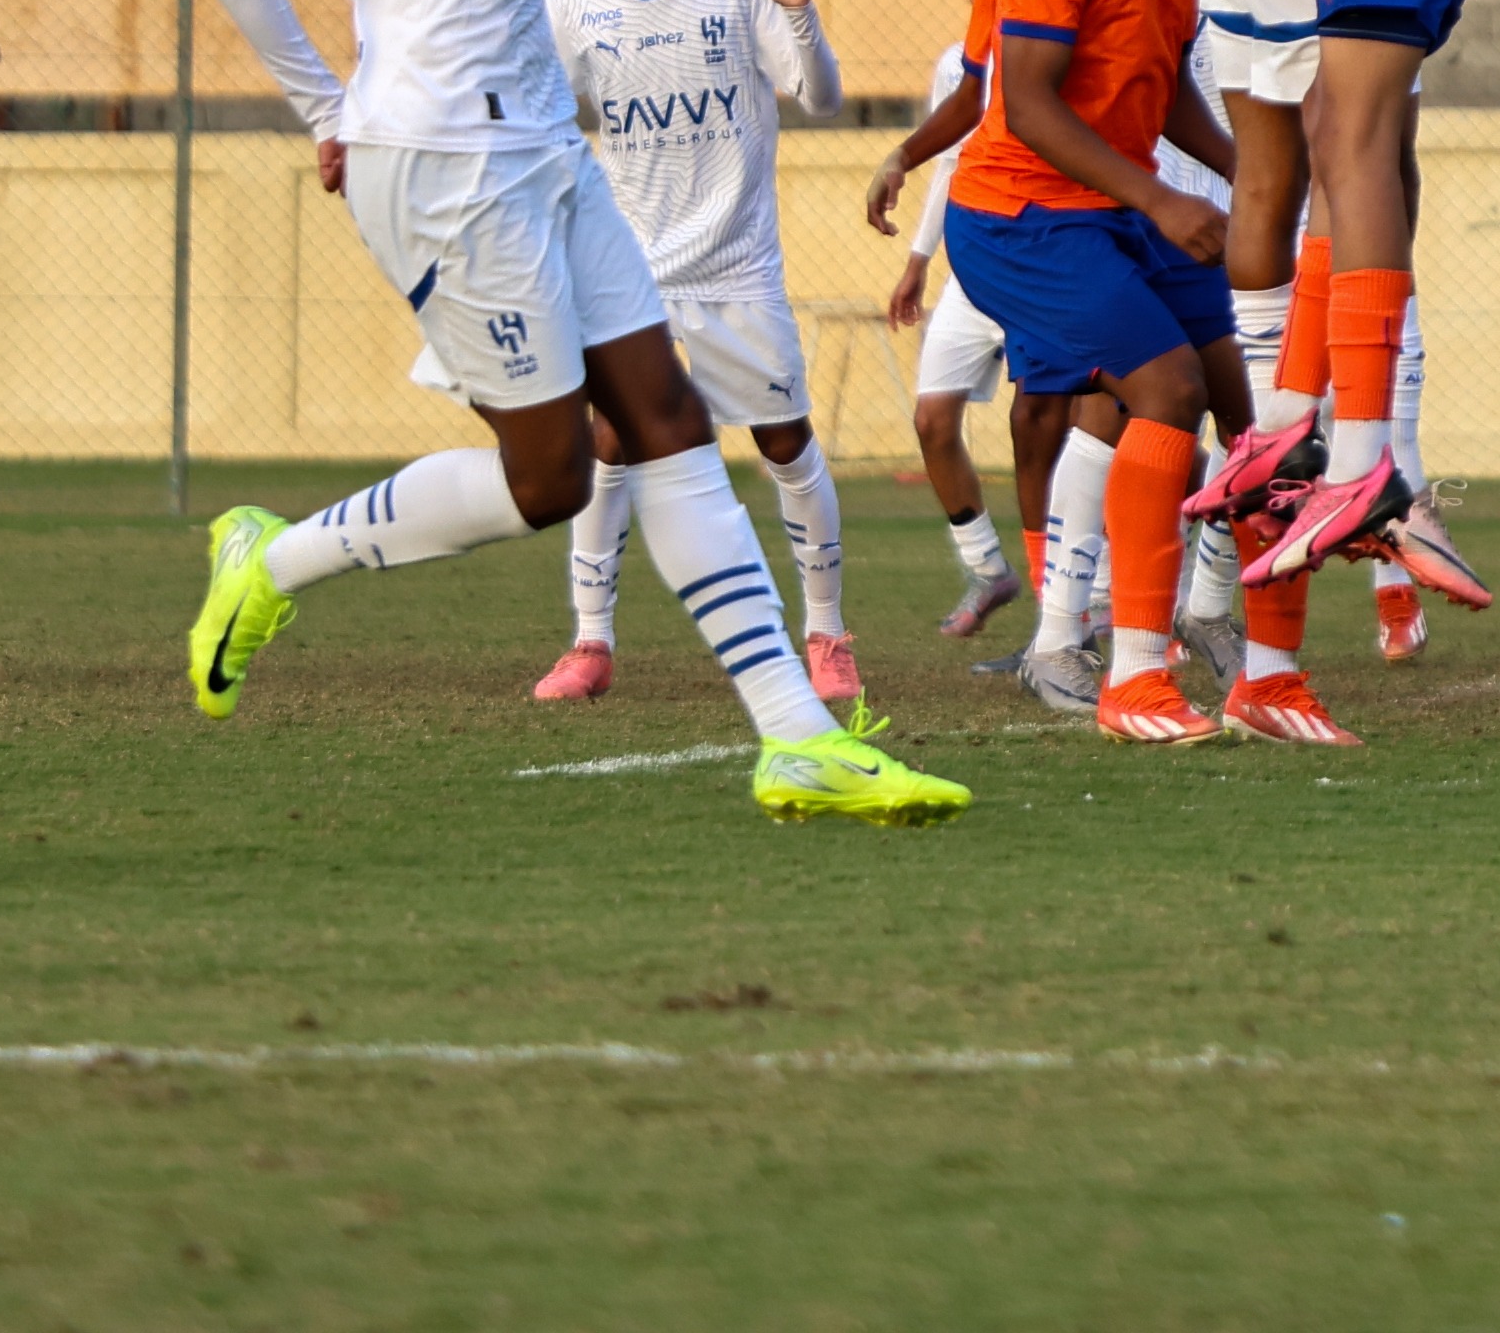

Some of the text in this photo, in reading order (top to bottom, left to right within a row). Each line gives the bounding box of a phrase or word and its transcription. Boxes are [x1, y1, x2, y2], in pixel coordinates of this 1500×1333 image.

[580, 7, 624, 27] flynas
[635, 31, 685, 51] jahez
[602, 84, 739, 135] SAVVY
[677, 127, 743, 146] GROUP
